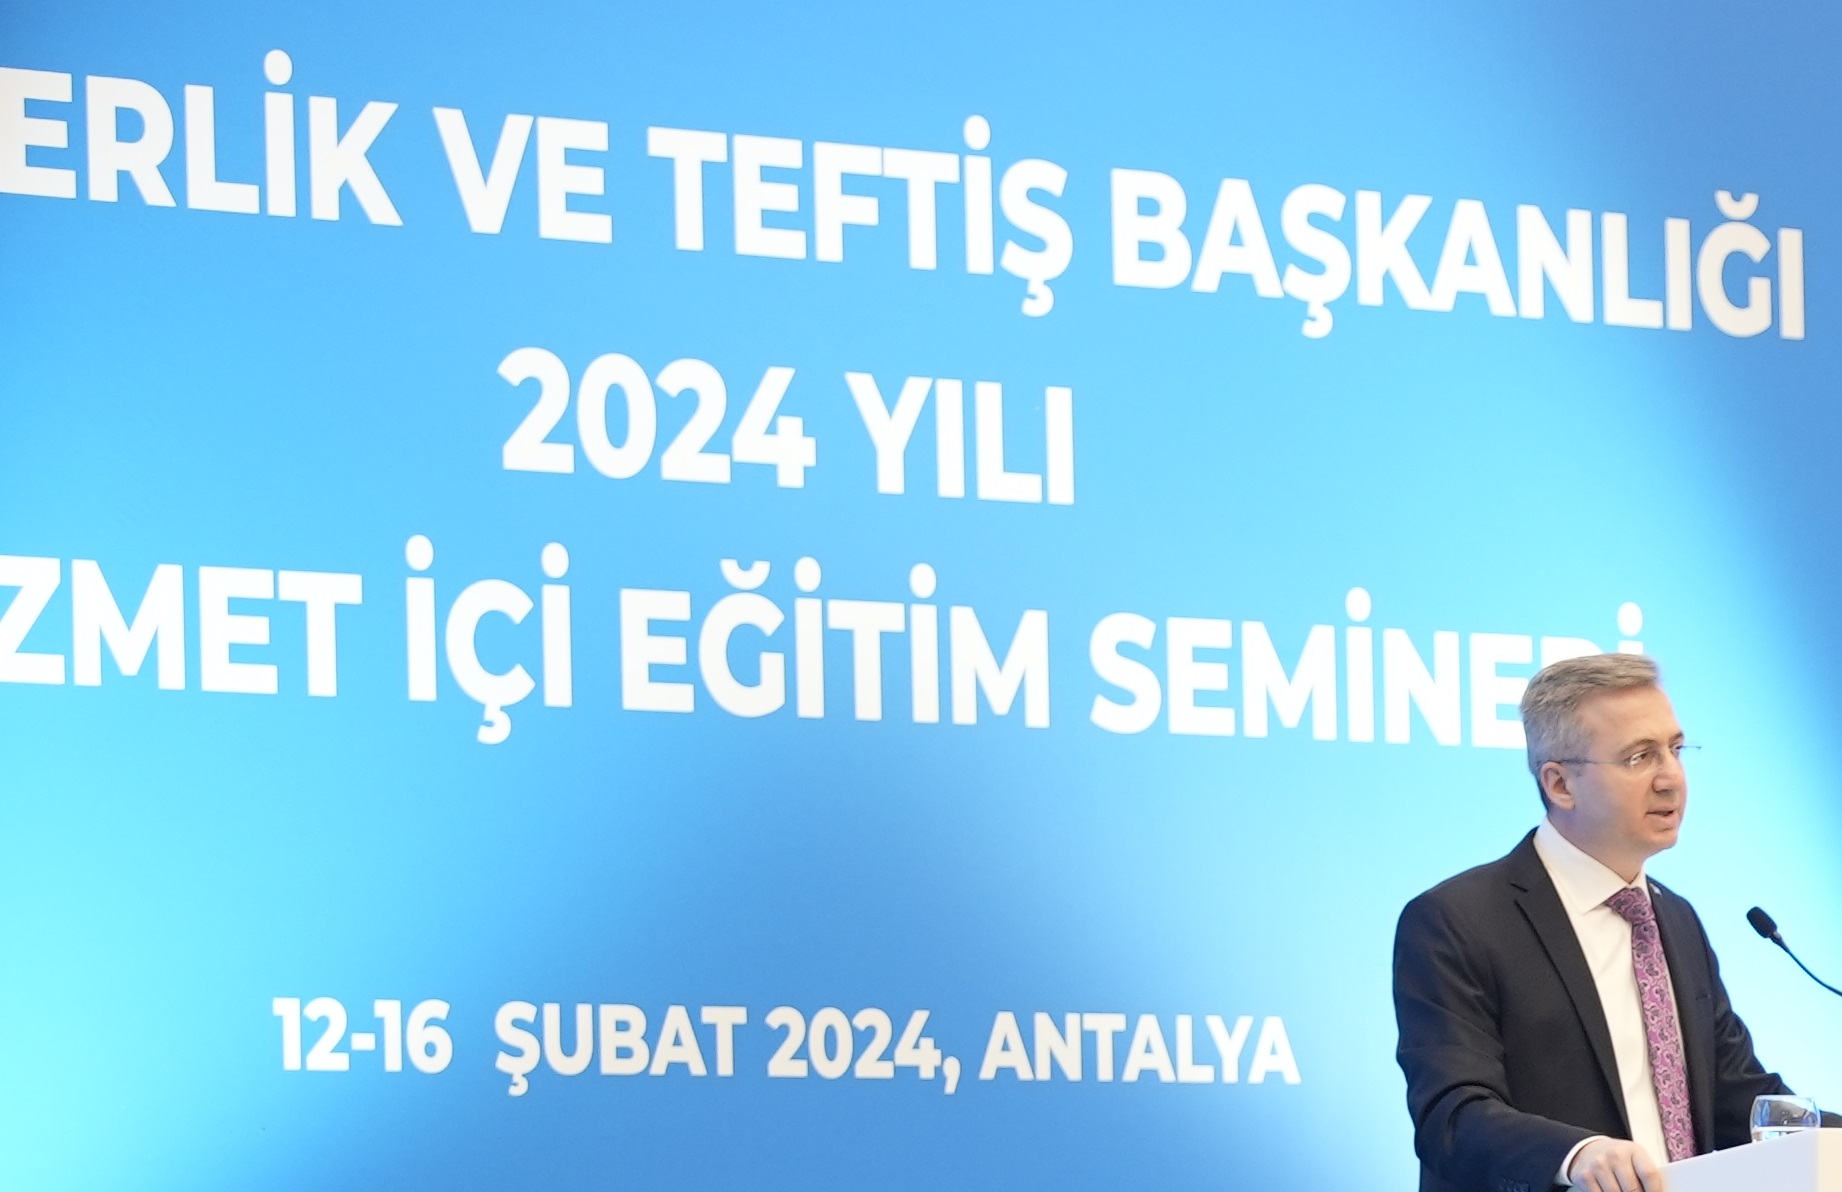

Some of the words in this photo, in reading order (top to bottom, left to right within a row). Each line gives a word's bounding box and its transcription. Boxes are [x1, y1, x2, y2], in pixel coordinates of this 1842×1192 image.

[432, 106, 614, 245] VE
[647, 114, 1074, 317] TEFTİŞ
[1110, 168, 1805, 340] BAŞKANLIĞI
[496, 346, 818, 489] 2024
[844, 371, 1076, 506] YILI
[404, 534, 573, 745] İÇİ
[619, 556, 1051, 730] EĞİTİM
[1089, 586, 1644, 751] SEMİNE
[272, 996, 454, 1074] 12-16
[494, 1000, 748, 1097] ŞUBAT
[764, 1006, 961, 1095] 2024,
[978, 1012, 1302, 1086] ANTALYA
